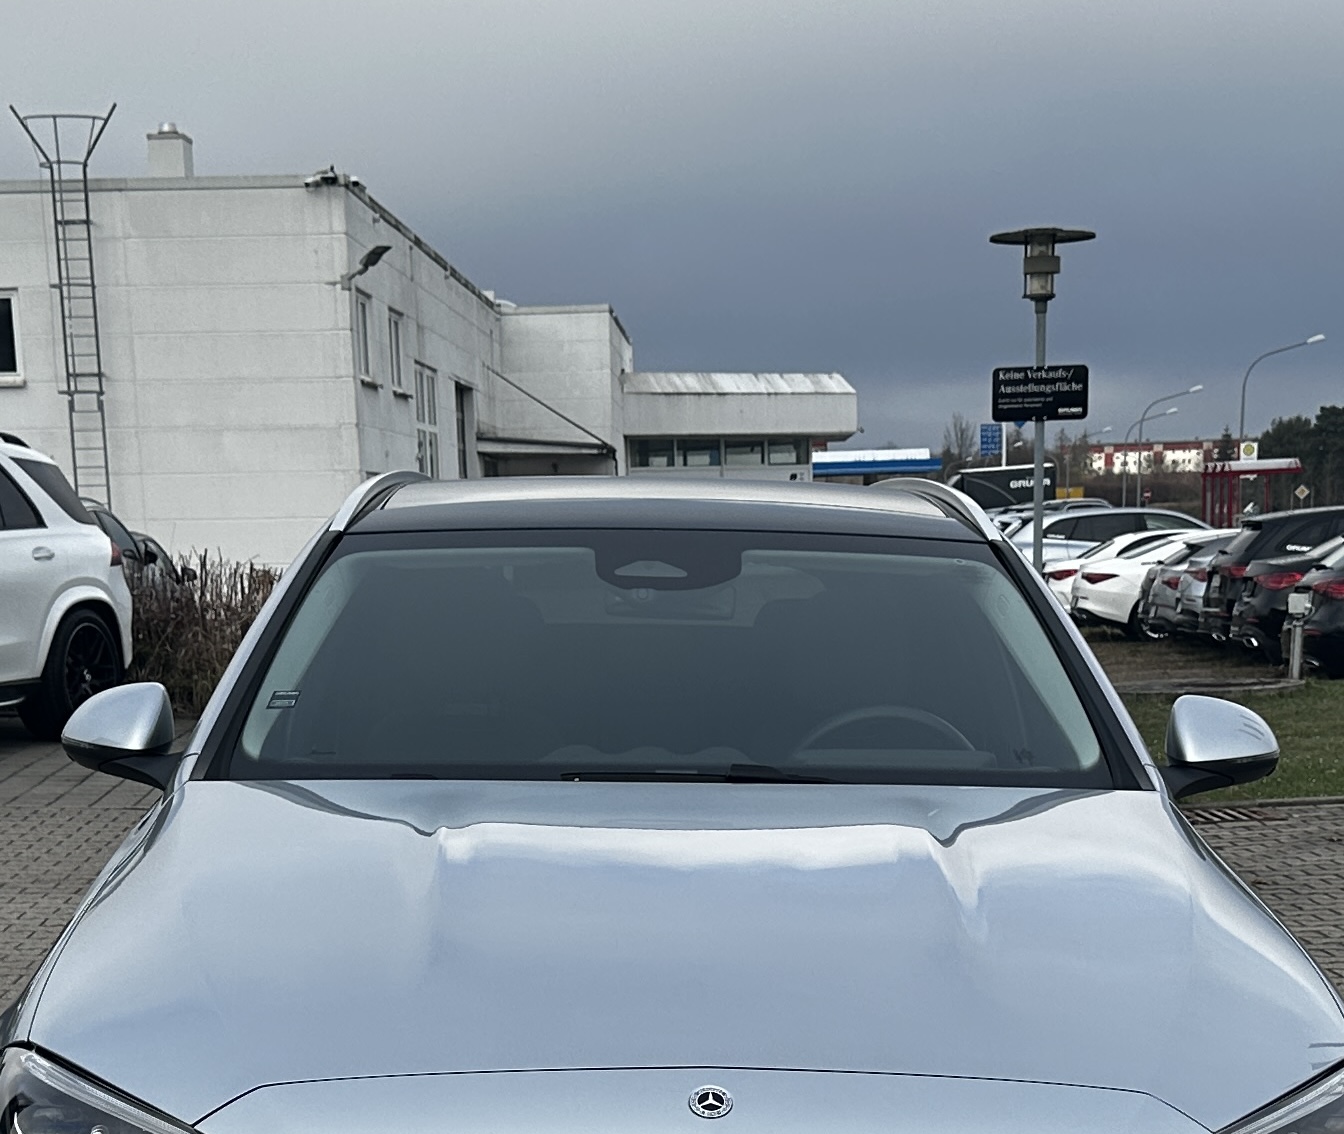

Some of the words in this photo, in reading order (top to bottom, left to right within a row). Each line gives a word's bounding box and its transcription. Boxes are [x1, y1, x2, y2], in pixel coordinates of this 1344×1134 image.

[998, 370, 1025, 380] Keine
[999, 382, 1083, 394] Ausstellungsfläche
[1009, 478, 1051, 489] GRUA
